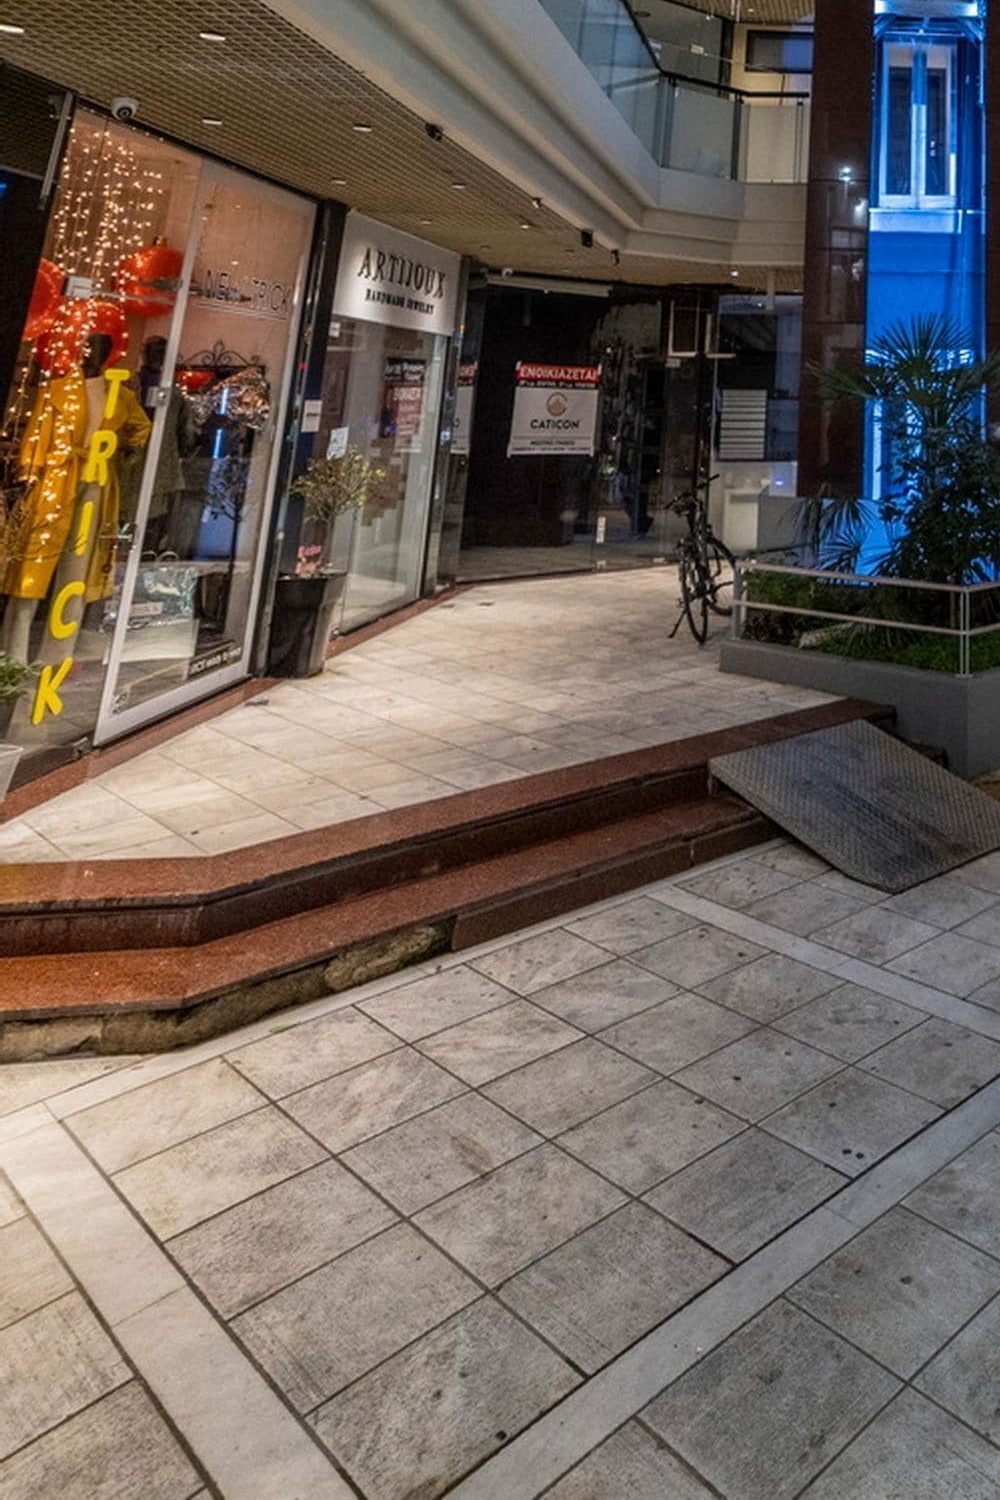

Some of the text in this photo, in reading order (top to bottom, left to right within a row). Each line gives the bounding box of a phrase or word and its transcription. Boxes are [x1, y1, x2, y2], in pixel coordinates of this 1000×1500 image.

[358, 248, 447, 299] ARTIJOUX
[519, 366, 597, 381] ΕΝΟΙΚΙΑΖΕΤΑΙ
[530, 419, 580, 430] CATICON
